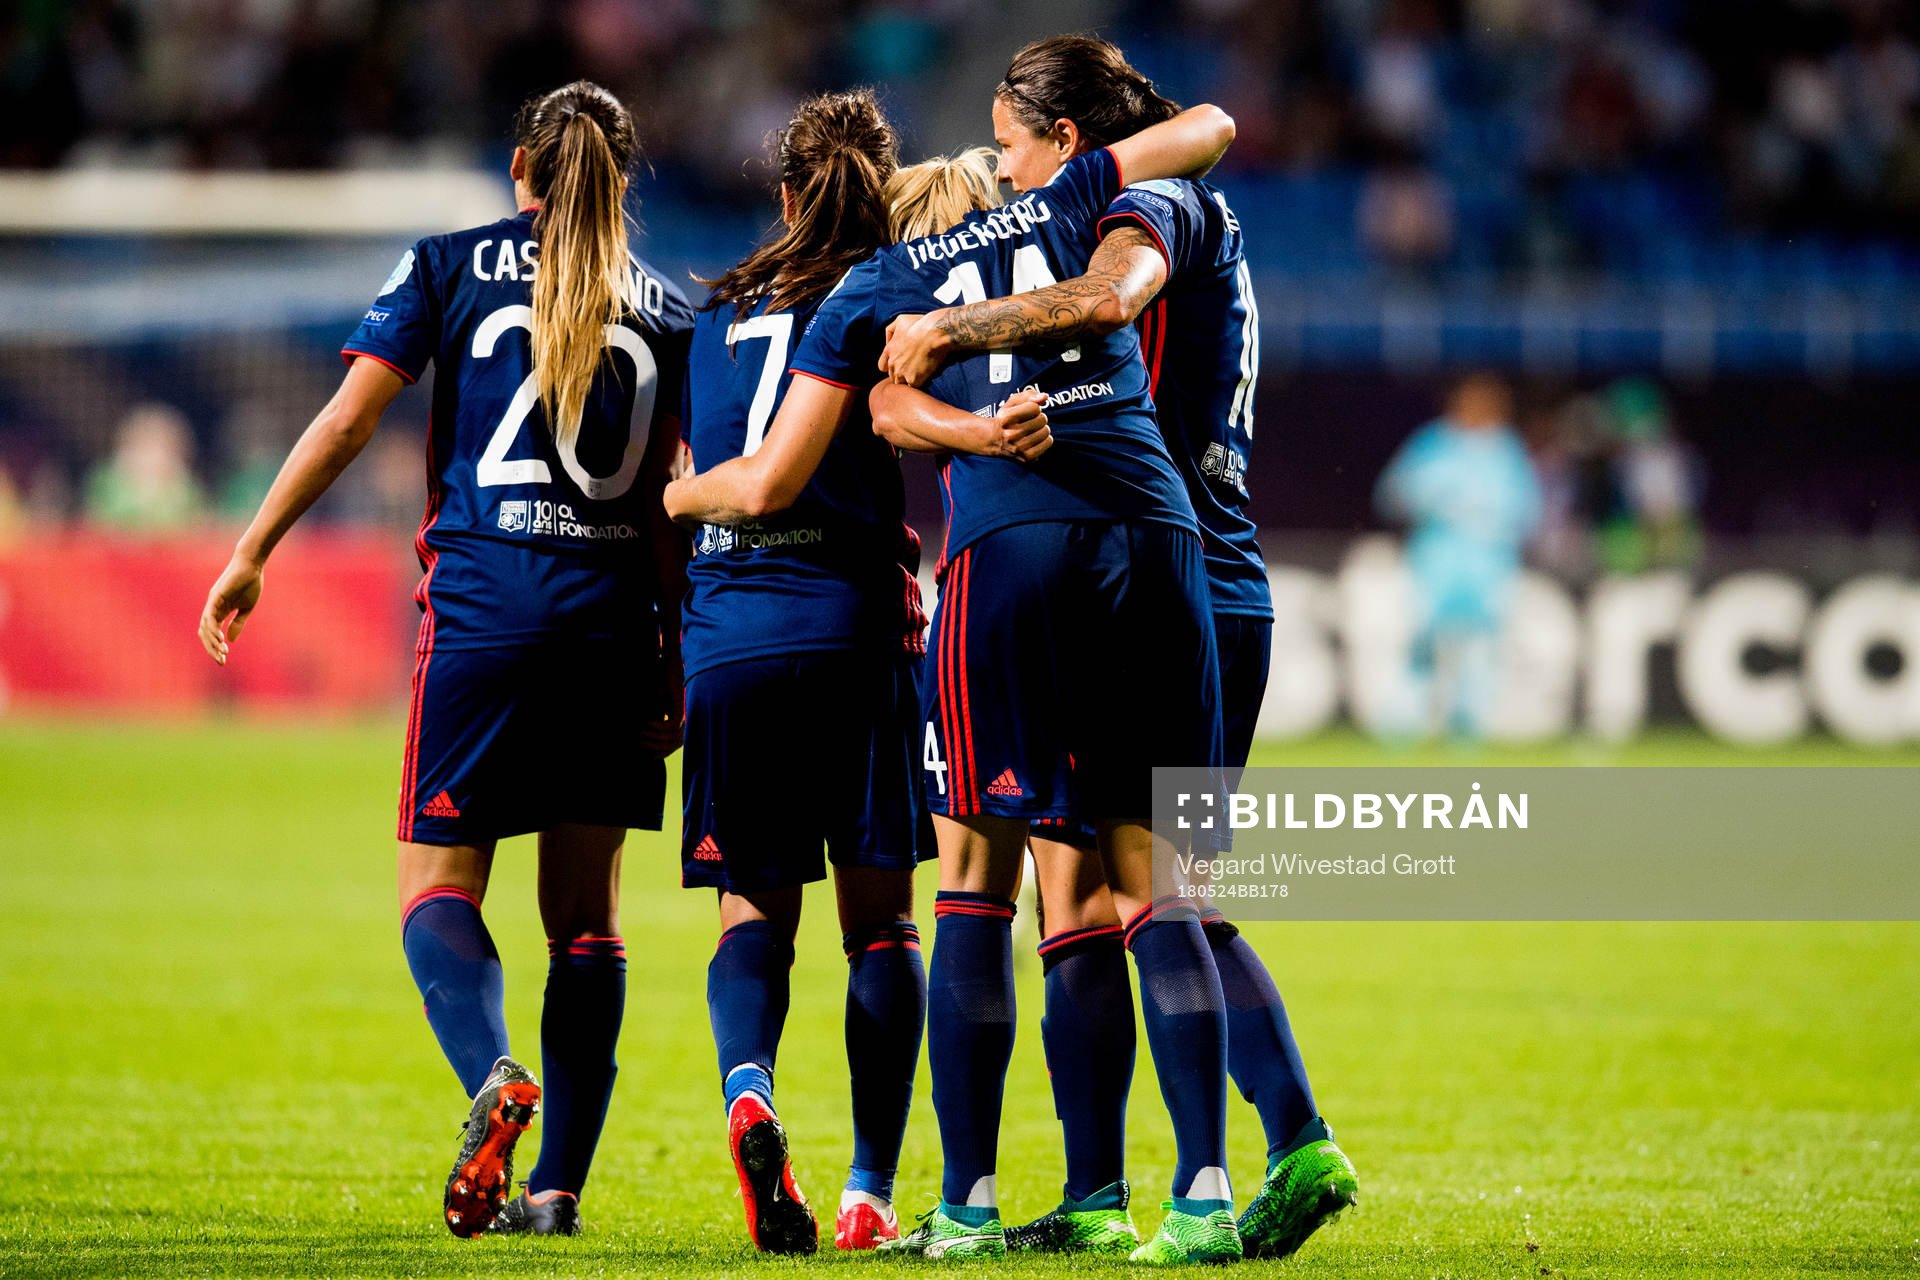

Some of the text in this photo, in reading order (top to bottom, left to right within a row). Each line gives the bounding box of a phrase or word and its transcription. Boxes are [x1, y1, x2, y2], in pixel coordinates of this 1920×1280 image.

[725, 313, 794, 457] 7
[471, 304, 658, 500] 20
[533, 500, 553, 521] 10
[558, 504, 577, 521] OL
[559, 521, 640, 540] FONDATION
[741, 528, 823, 549] FONDATION
[987, 785, 1023, 797] adidas
[422, 807, 460, 818] adidas
